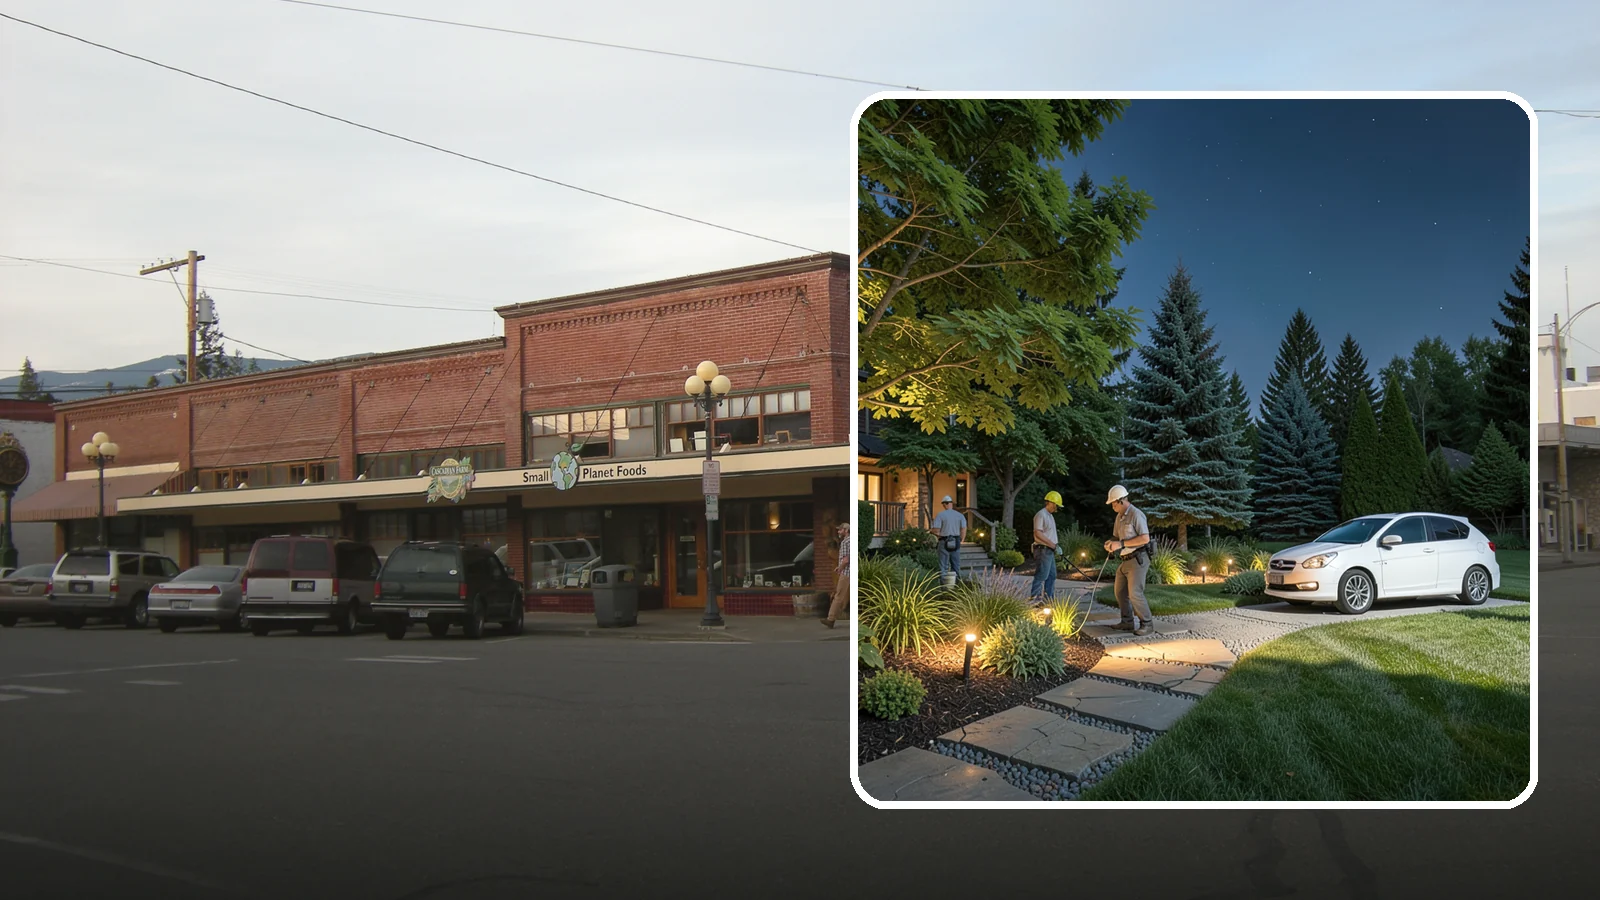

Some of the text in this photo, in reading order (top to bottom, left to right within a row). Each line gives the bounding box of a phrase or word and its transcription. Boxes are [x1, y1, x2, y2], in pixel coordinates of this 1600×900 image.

[523, 463, 647, 482] Small Planet Foods
